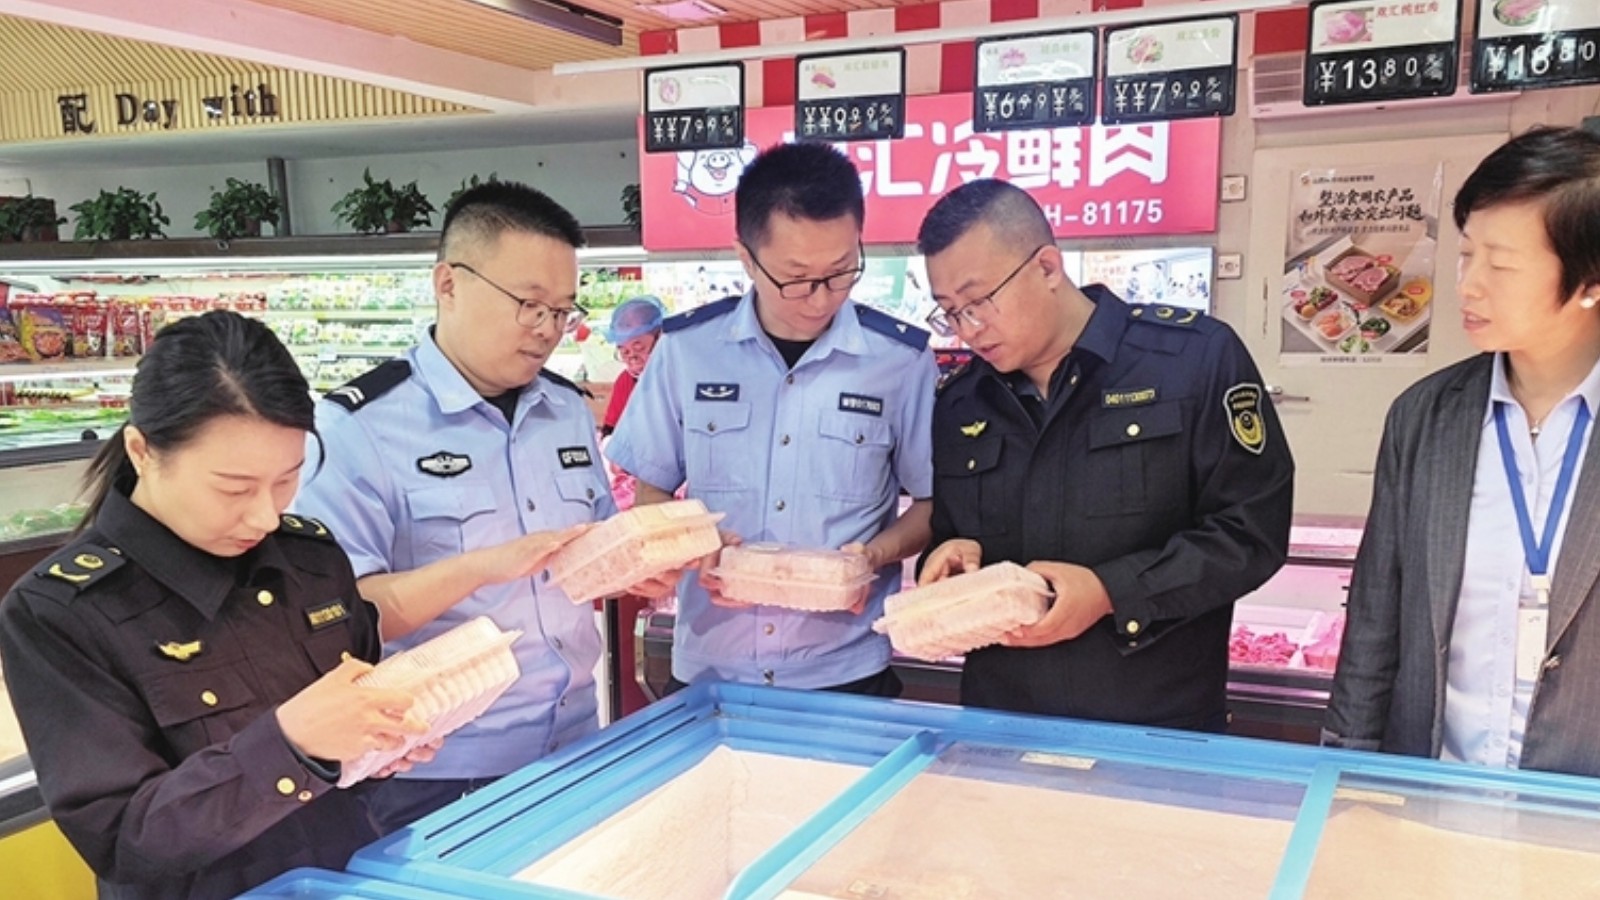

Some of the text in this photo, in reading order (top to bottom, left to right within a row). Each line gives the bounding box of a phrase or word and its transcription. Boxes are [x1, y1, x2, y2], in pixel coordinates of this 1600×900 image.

[115, 92, 178, 129] Day
[202, 84, 279, 119] with
[783, 119, 1170, 196] 汇冷鲜肉
